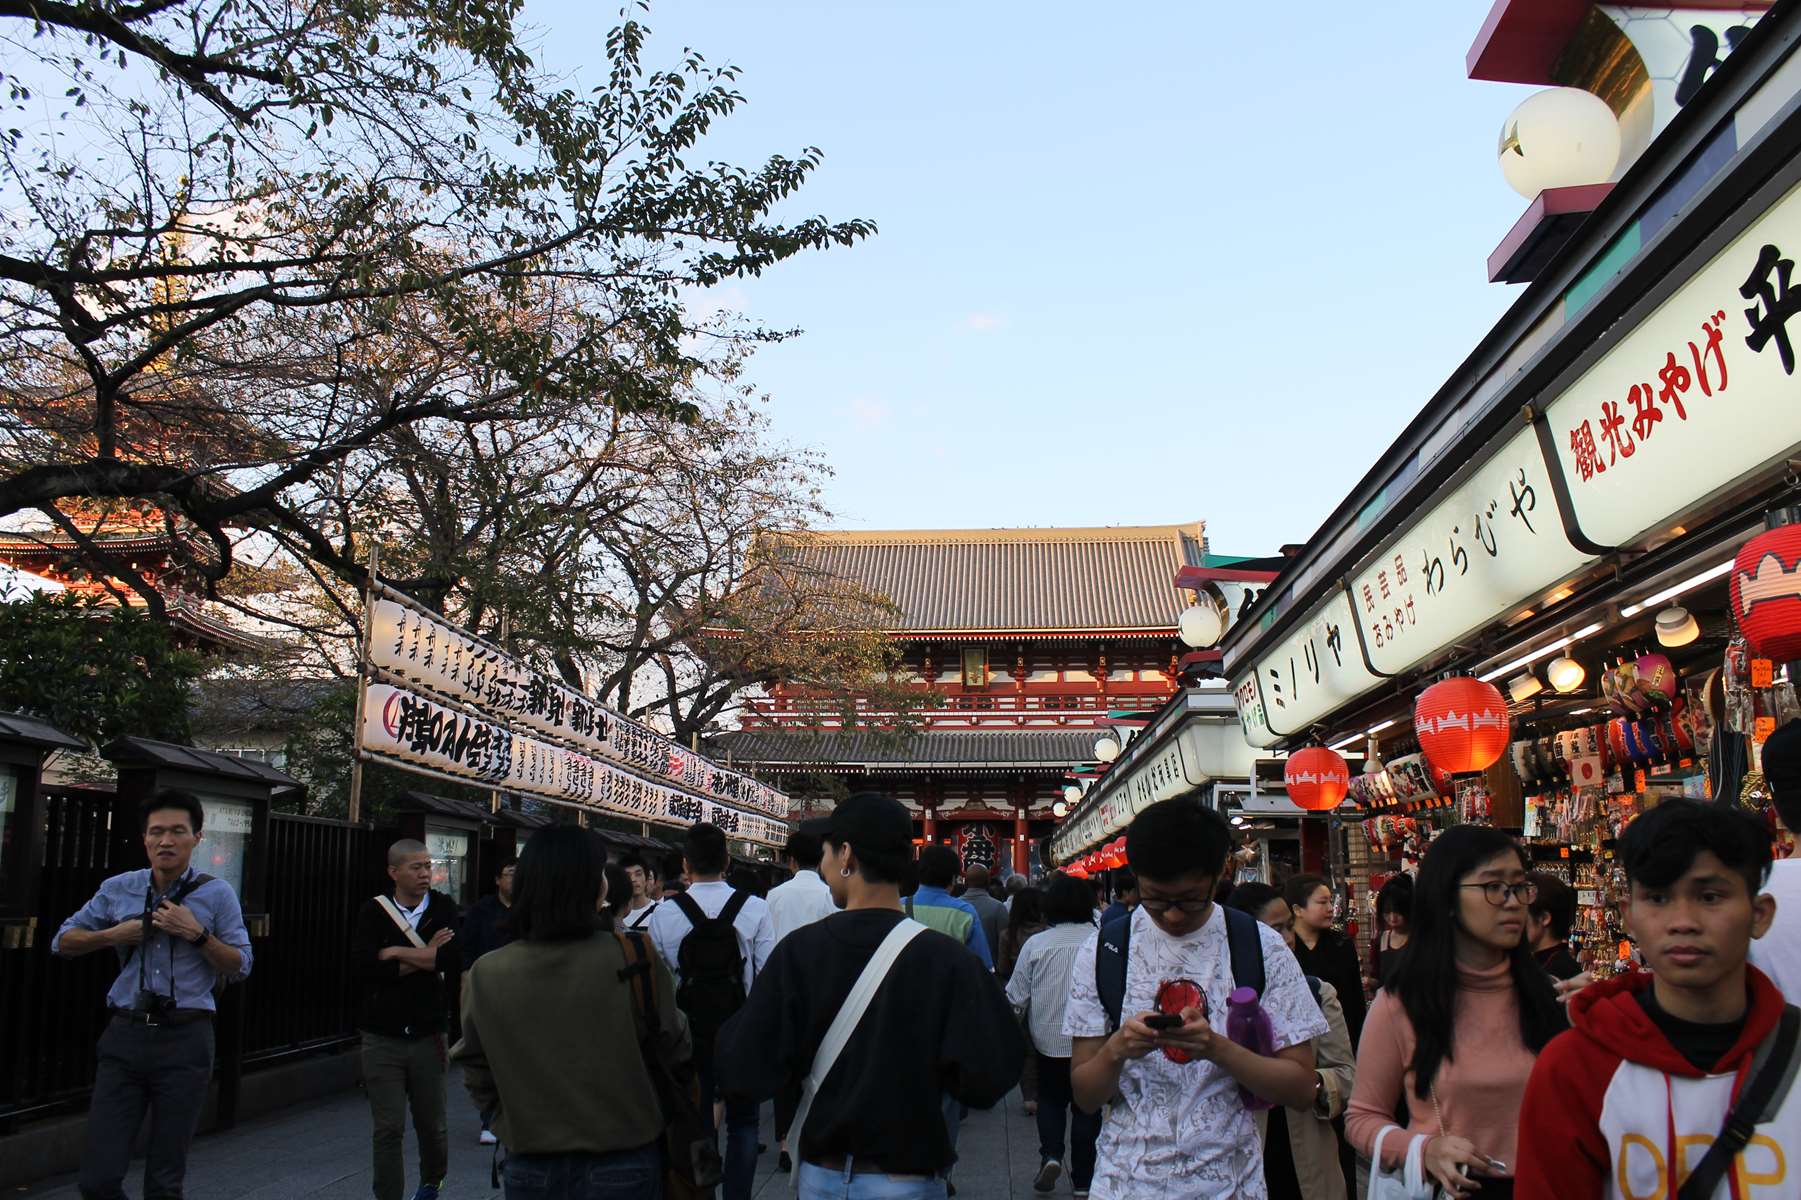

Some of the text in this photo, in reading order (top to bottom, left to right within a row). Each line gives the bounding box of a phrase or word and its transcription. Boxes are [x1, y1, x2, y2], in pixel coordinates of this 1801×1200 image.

[1570, 309, 1730, 483] 観光みやげ
[1422, 467, 1537, 598] わらびや
[1362, 553, 1408, 614] 民芸品
[1372, 592, 1416, 649] おみやげ
[1269, 621, 1342, 710] ミノリヤ
